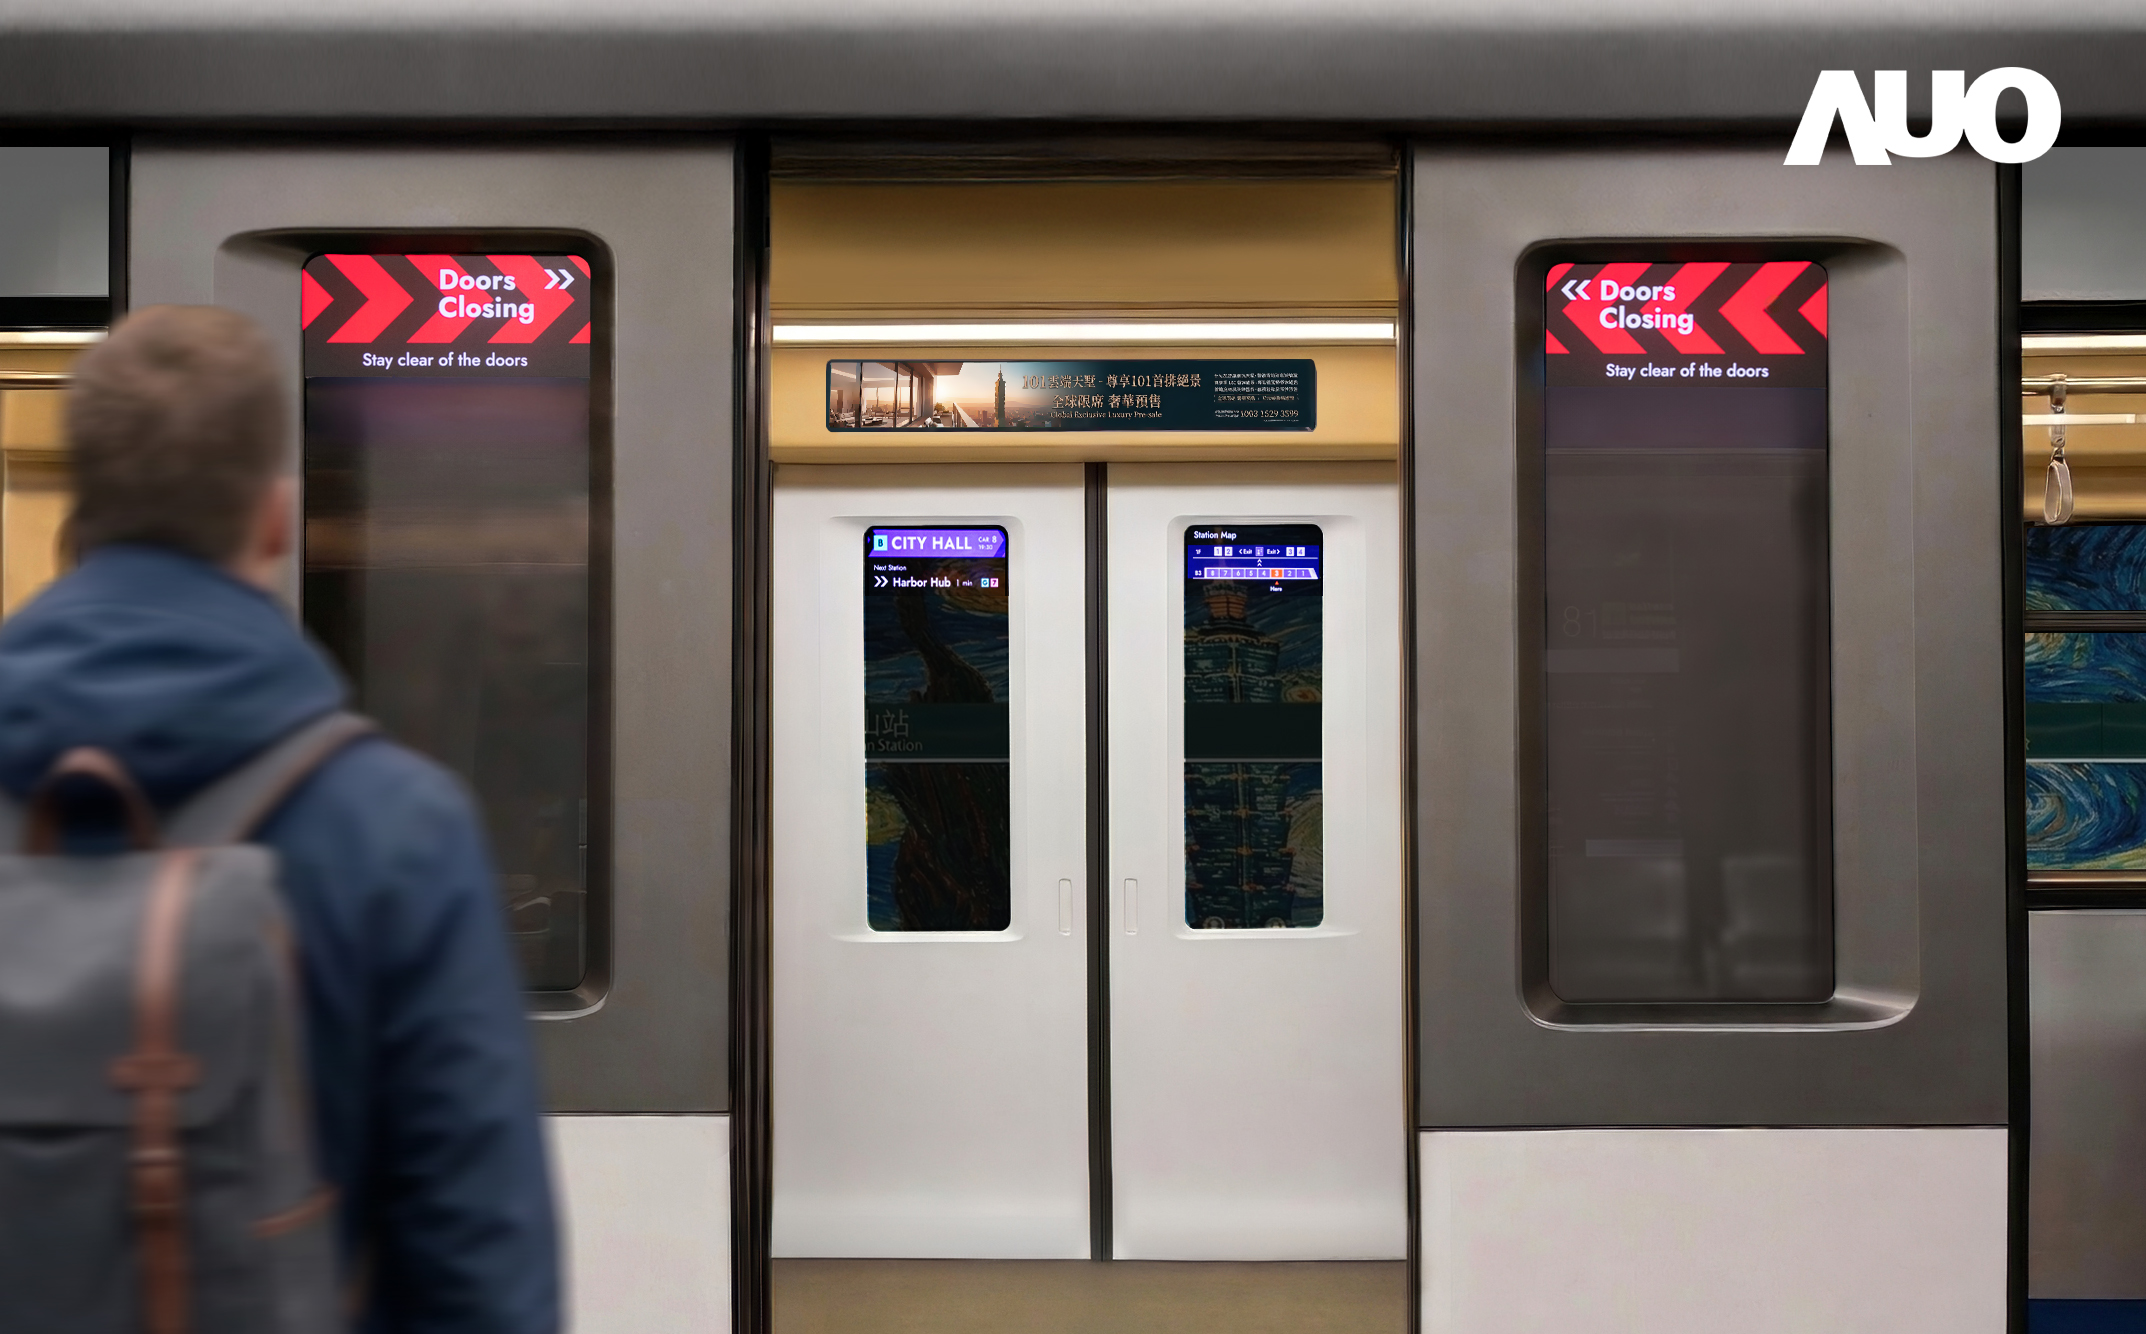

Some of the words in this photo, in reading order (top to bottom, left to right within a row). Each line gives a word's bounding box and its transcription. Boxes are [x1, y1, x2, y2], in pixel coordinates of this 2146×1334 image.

[439, 268, 516, 290] Doors
[1600, 279, 1676, 301] Doors
[438, 295, 535, 324] Closing
[1599, 305, 1694, 335] Closing
[362, 352, 393, 369] Stay
[398, 352, 434, 367] clear
[438, 352, 454, 367] of
[458, 352, 481, 367] the
[485, 352, 528, 367] doors
[1605, 363, 1636, 380] Stay
[1640, 363, 1675, 378] clear
[1680, 363, 1696, 378] of
[1699, 363, 1722, 378] the
[1726, 363, 1769, 378] doors
[1052, 393, 1105, 409] 全球限席
[1108, 393, 1162, 409] 奢華預售
[1108, 411, 1132, 420] Luxury
[891, 536, 927, 550] CITY
[932, 536, 972, 550] HALL
[1193, 530, 1219, 539] Station
[1220, 531, 1237, 541] Map
[892, 576, 927, 587] Harbor
[930, 576, 951, 587] Hub
[962, 579, 973, 587] min
[878, 738, 923, 752] Station
